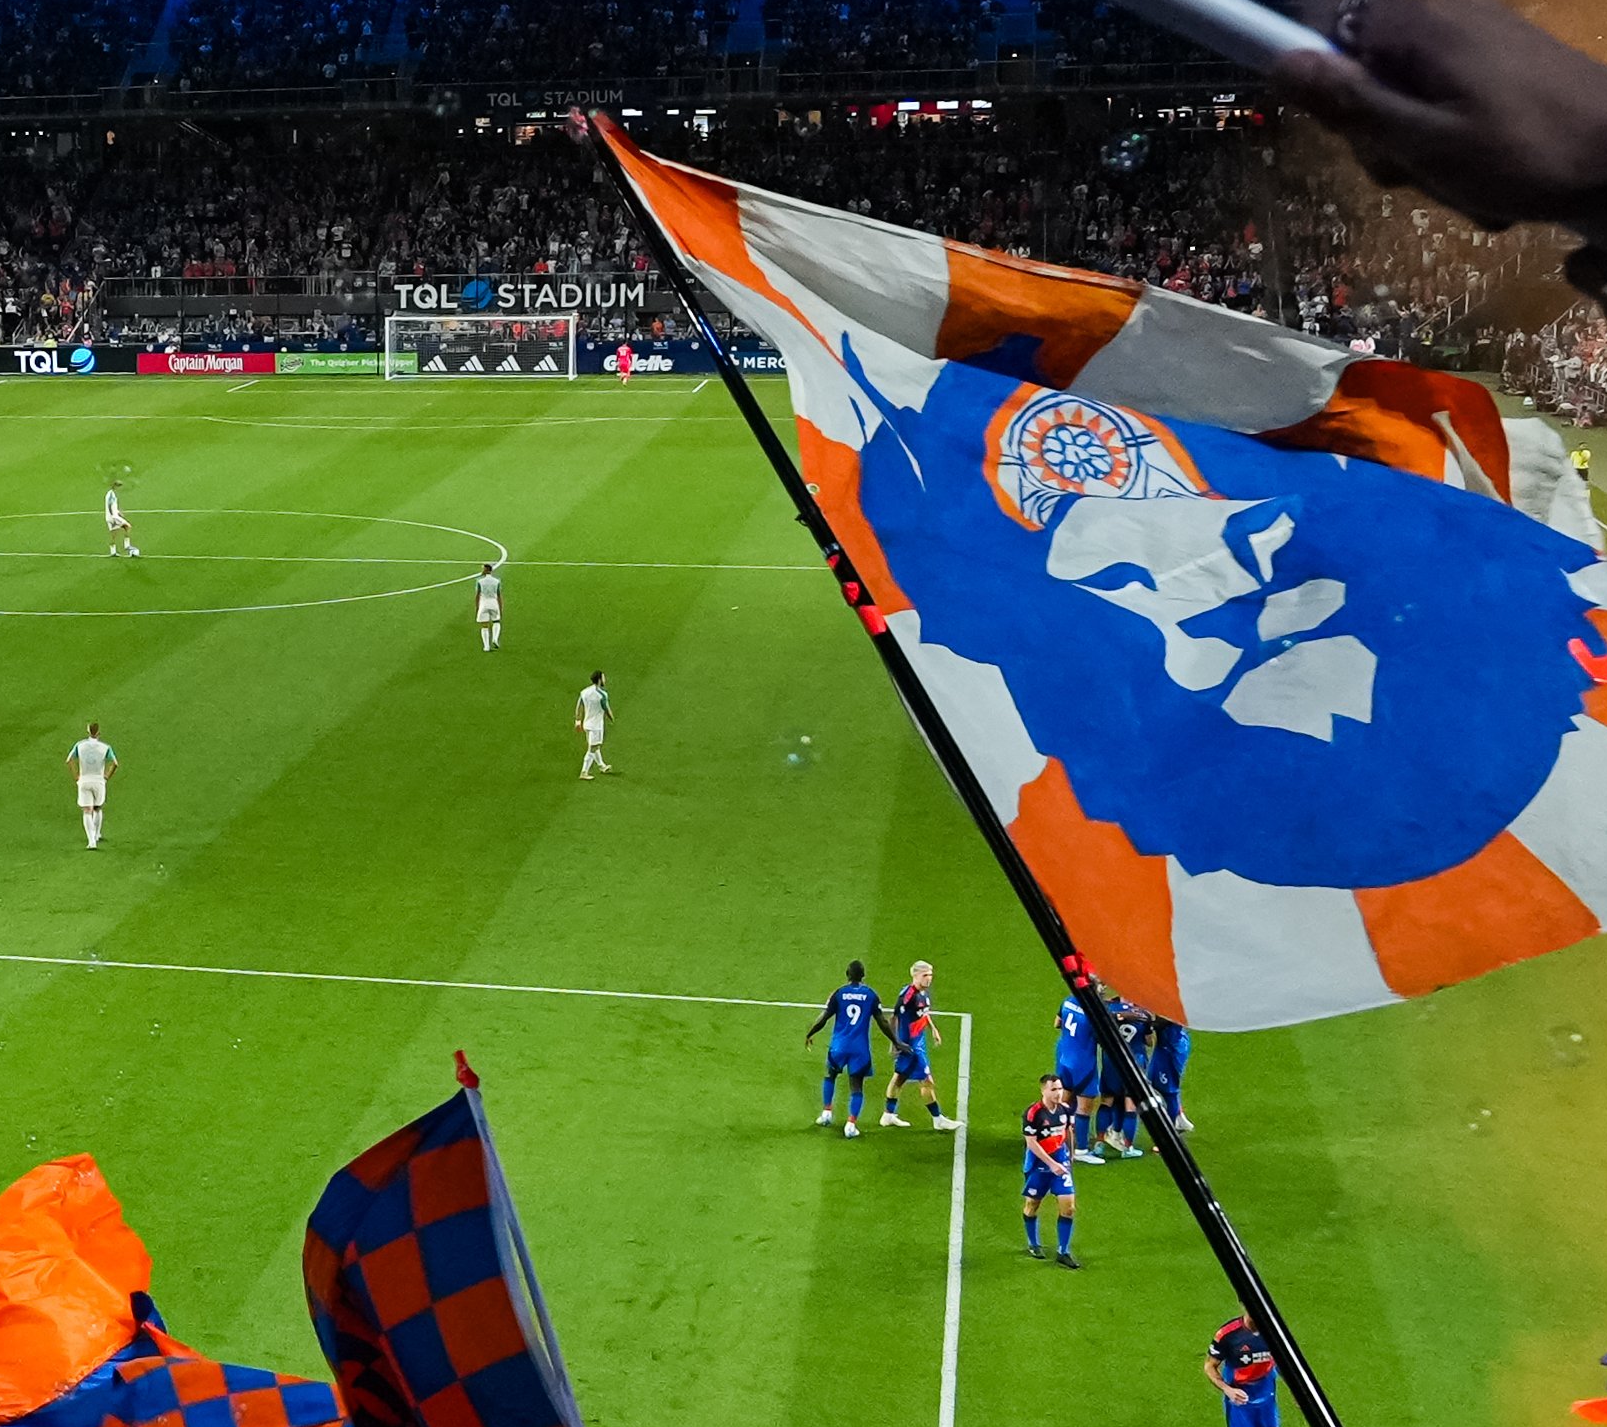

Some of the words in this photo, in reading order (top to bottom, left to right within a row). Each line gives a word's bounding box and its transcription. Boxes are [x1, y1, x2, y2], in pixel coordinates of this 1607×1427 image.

[487, 93, 523, 107] TQL
[544, 90, 623, 105] STADIUM
[394, 284, 458, 309] TQL
[497, 283, 645, 308] STADIUM
[14, 350, 68, 373] TQL
[169, 354, 205, 372] Captain
[204, 355, 243, 372] Morgan
[603, 355, 673, 372] Glette
[846, 1004, 862, 1026] 9
[1064, 1013, 1077, 1037] 4
